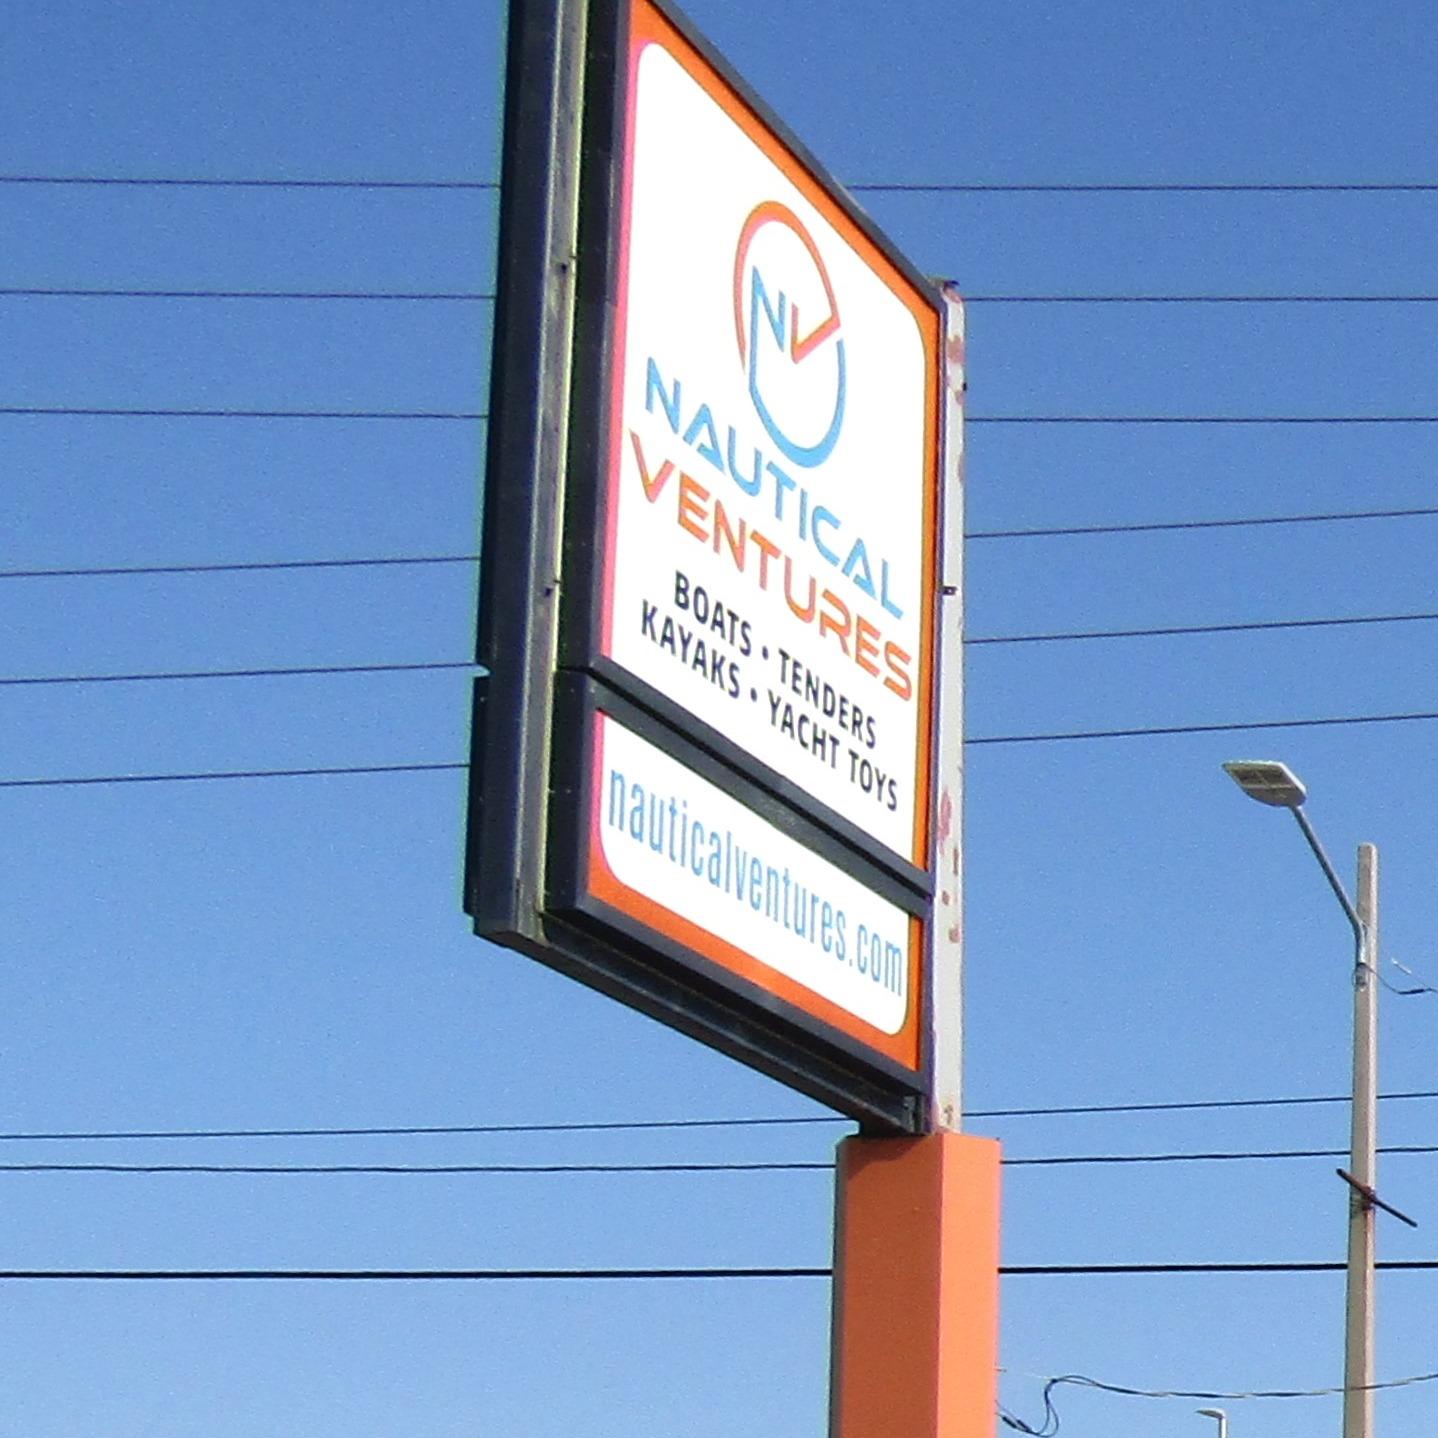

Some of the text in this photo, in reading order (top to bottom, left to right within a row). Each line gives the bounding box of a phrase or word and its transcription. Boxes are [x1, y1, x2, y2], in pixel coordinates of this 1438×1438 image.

[629, 428, 913, 702] VENTURES
[644, 356, 904, 620] NAUTICAL
[642, 598, 898, 813] KAYAKS YACHT TOYS
[674, 569, 877, 750] BOATS TENDERS
[608, 767, 903, 999] nauticalventures.com
